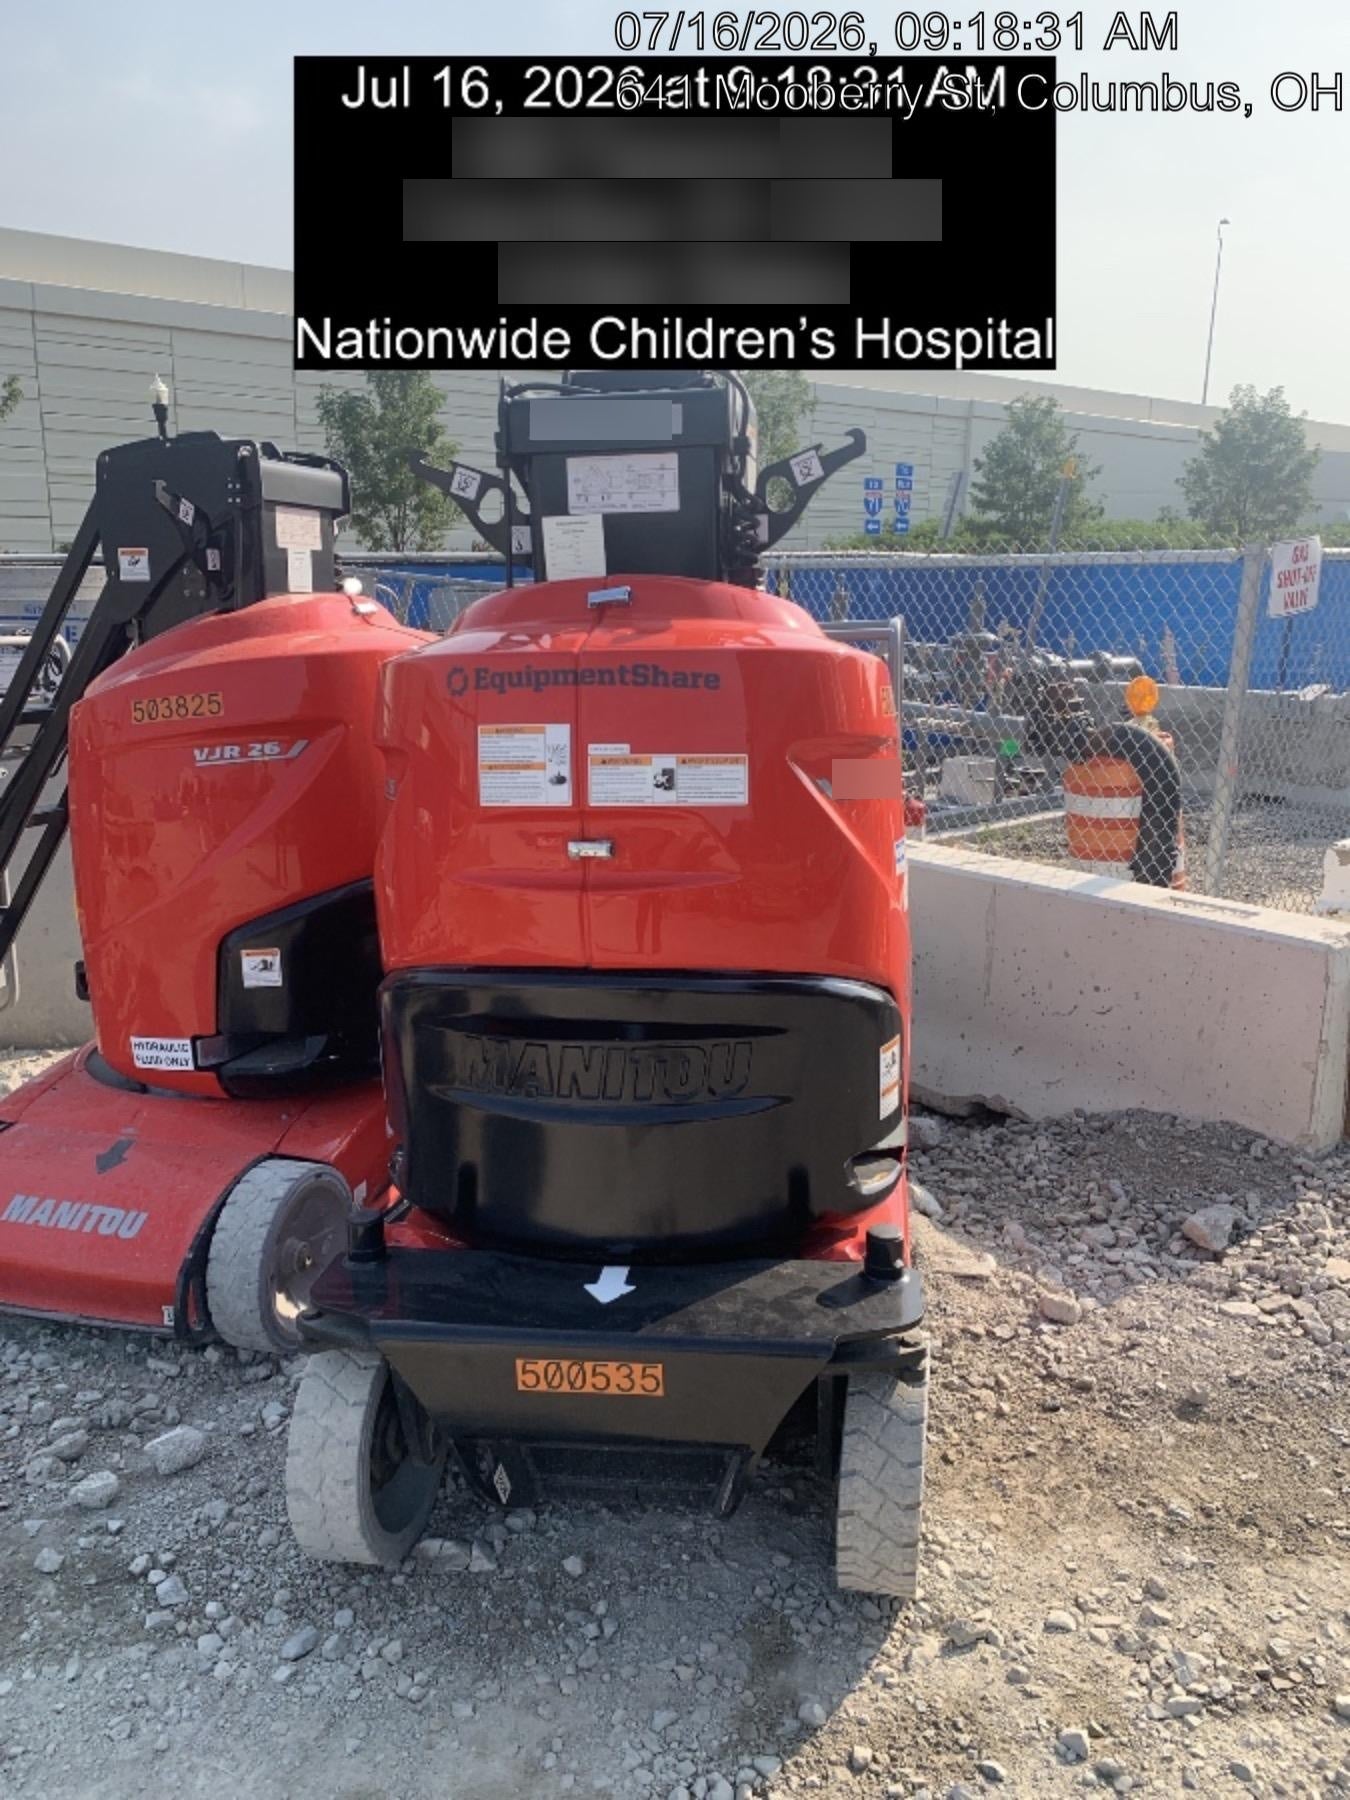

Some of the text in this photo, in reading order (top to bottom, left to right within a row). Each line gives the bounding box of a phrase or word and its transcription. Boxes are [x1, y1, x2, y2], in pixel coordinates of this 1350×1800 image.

[474, 664, 721, 694] EquipmentShare
[133, 692, 222, 722] 503825
[193, 741, 281, 761] VJR 26
[457, 1034, 752, 1099] MANITOU
[0, 1194, 149, 1239] MANITOU
[521, 1361, 661, 1392] 500535
